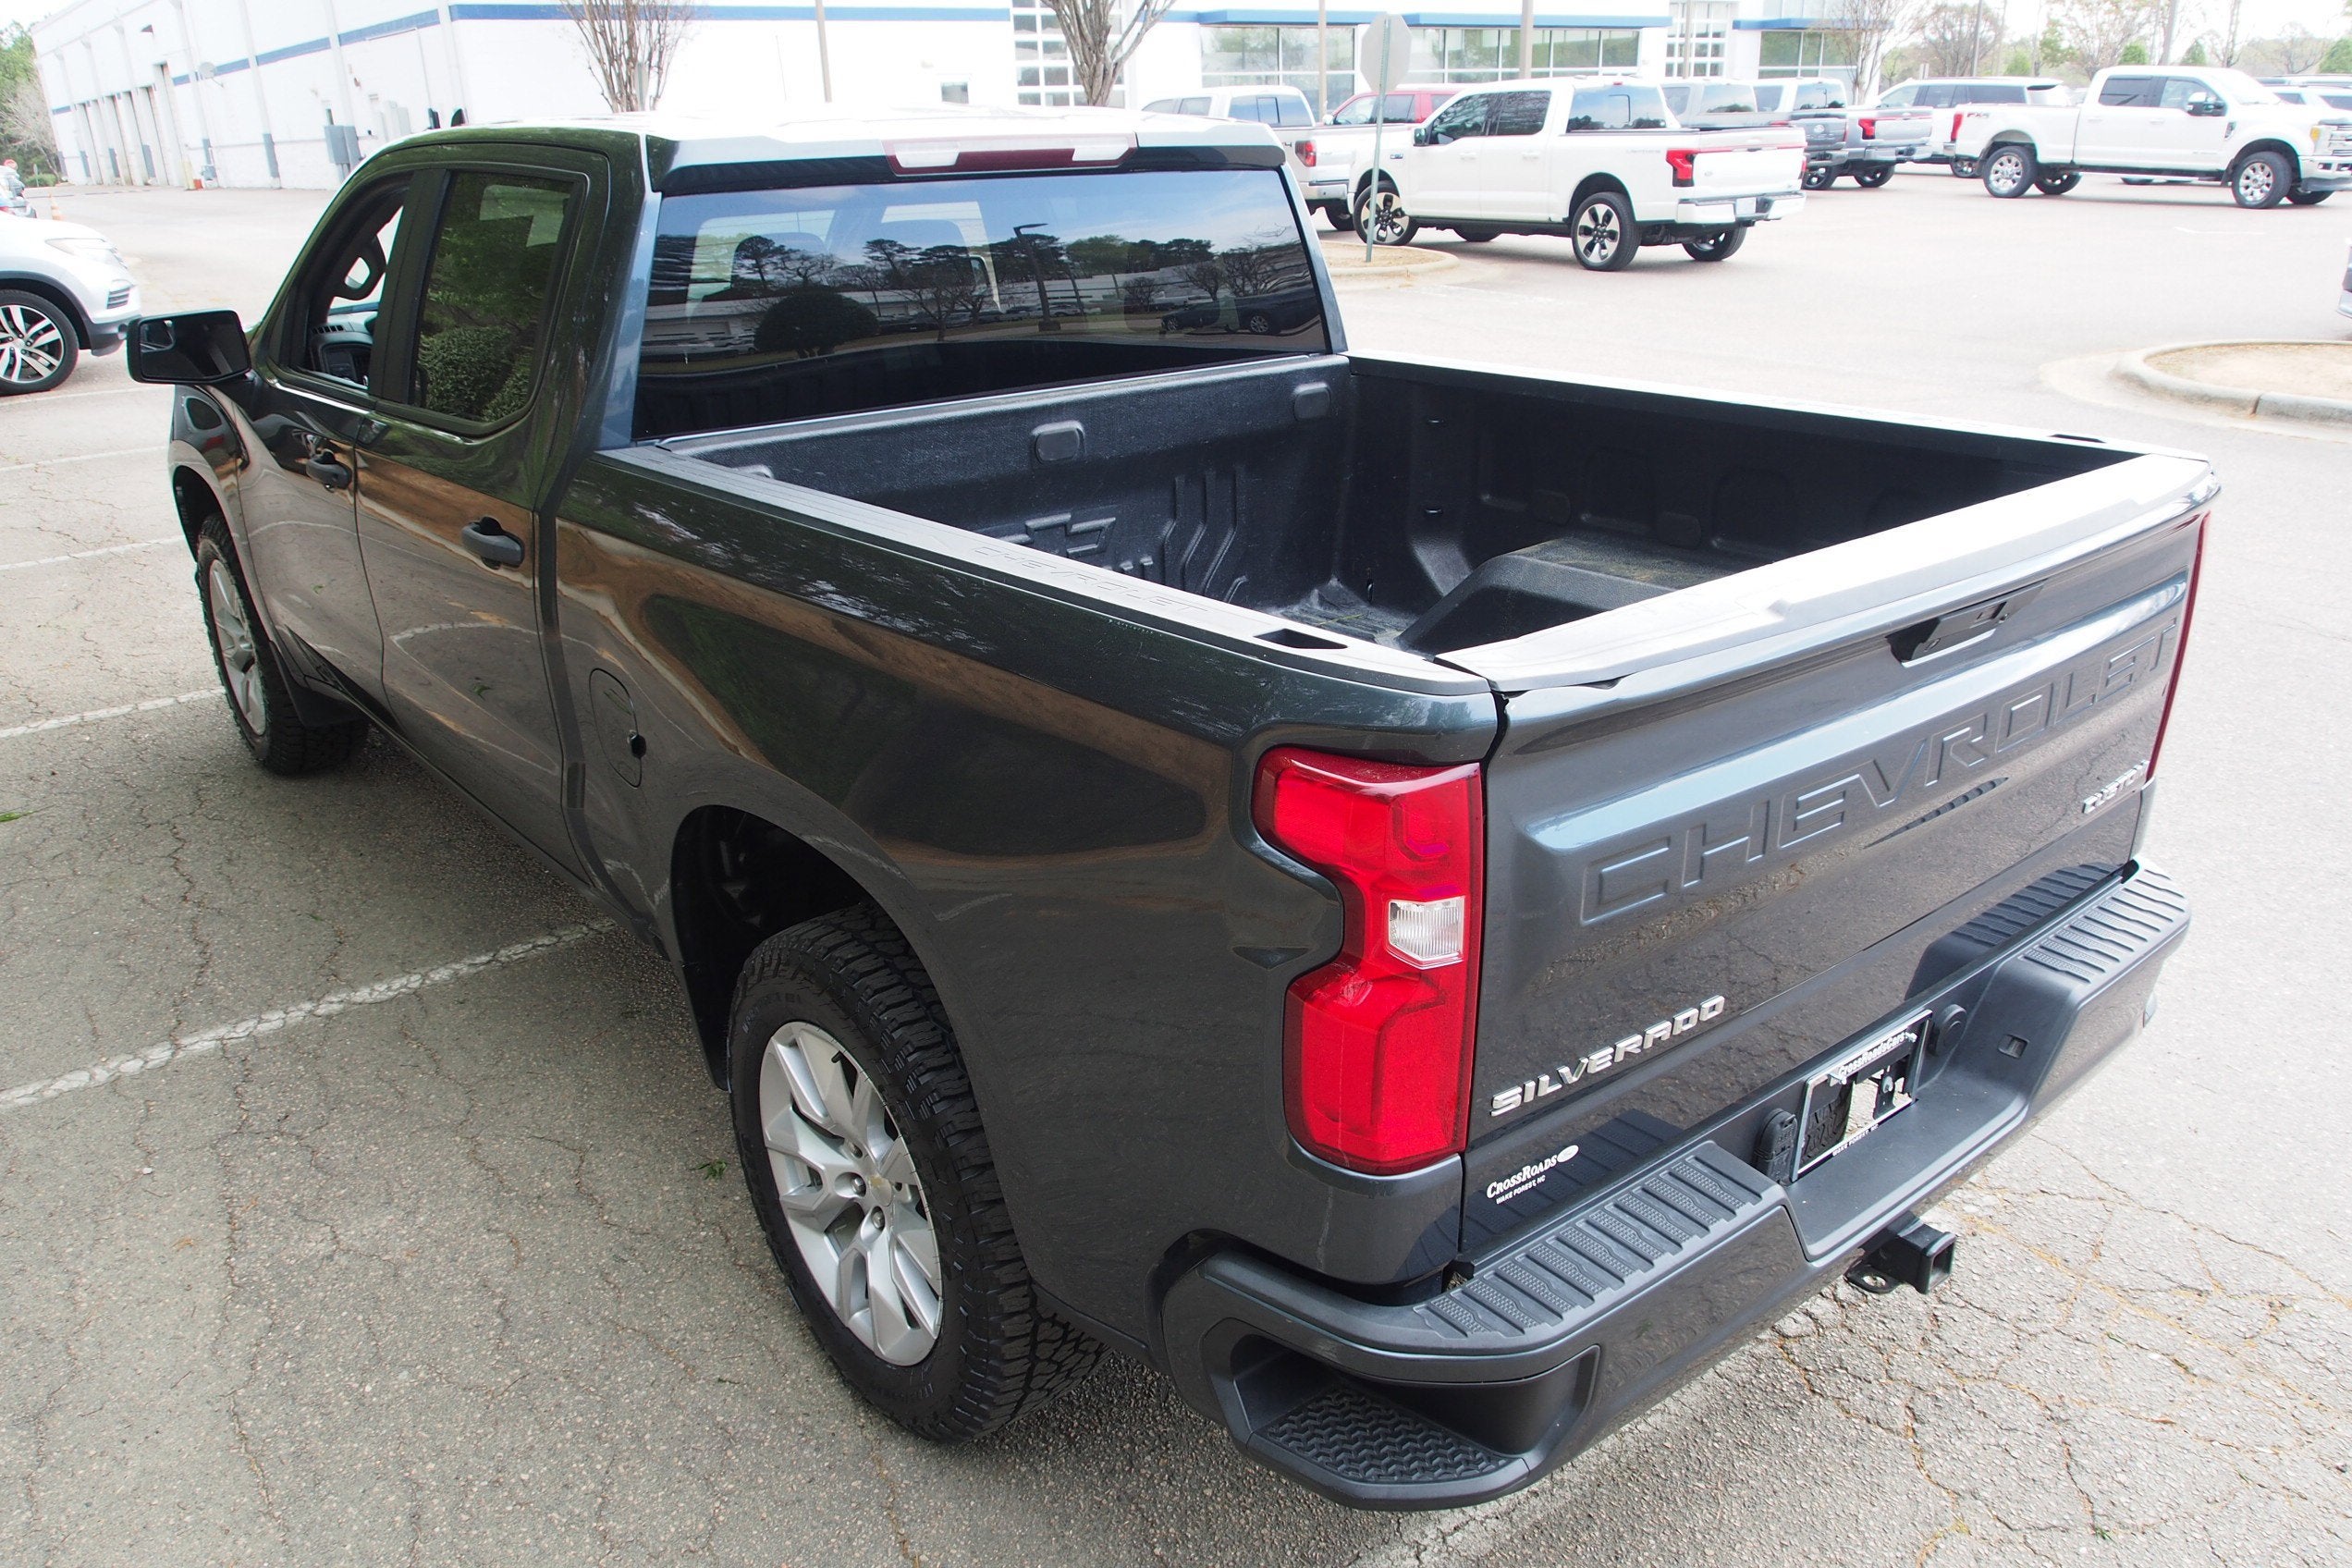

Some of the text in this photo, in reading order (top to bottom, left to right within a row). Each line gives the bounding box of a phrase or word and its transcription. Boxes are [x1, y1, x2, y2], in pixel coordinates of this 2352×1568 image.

[1579, 617, 2177, 925] CHEVROLET
[1489, 995, 1725, 1117] SILVERADO
[1496, 1191, 1513, 1205] WAKE
[1537, 1174, 1546, 1184] NC
